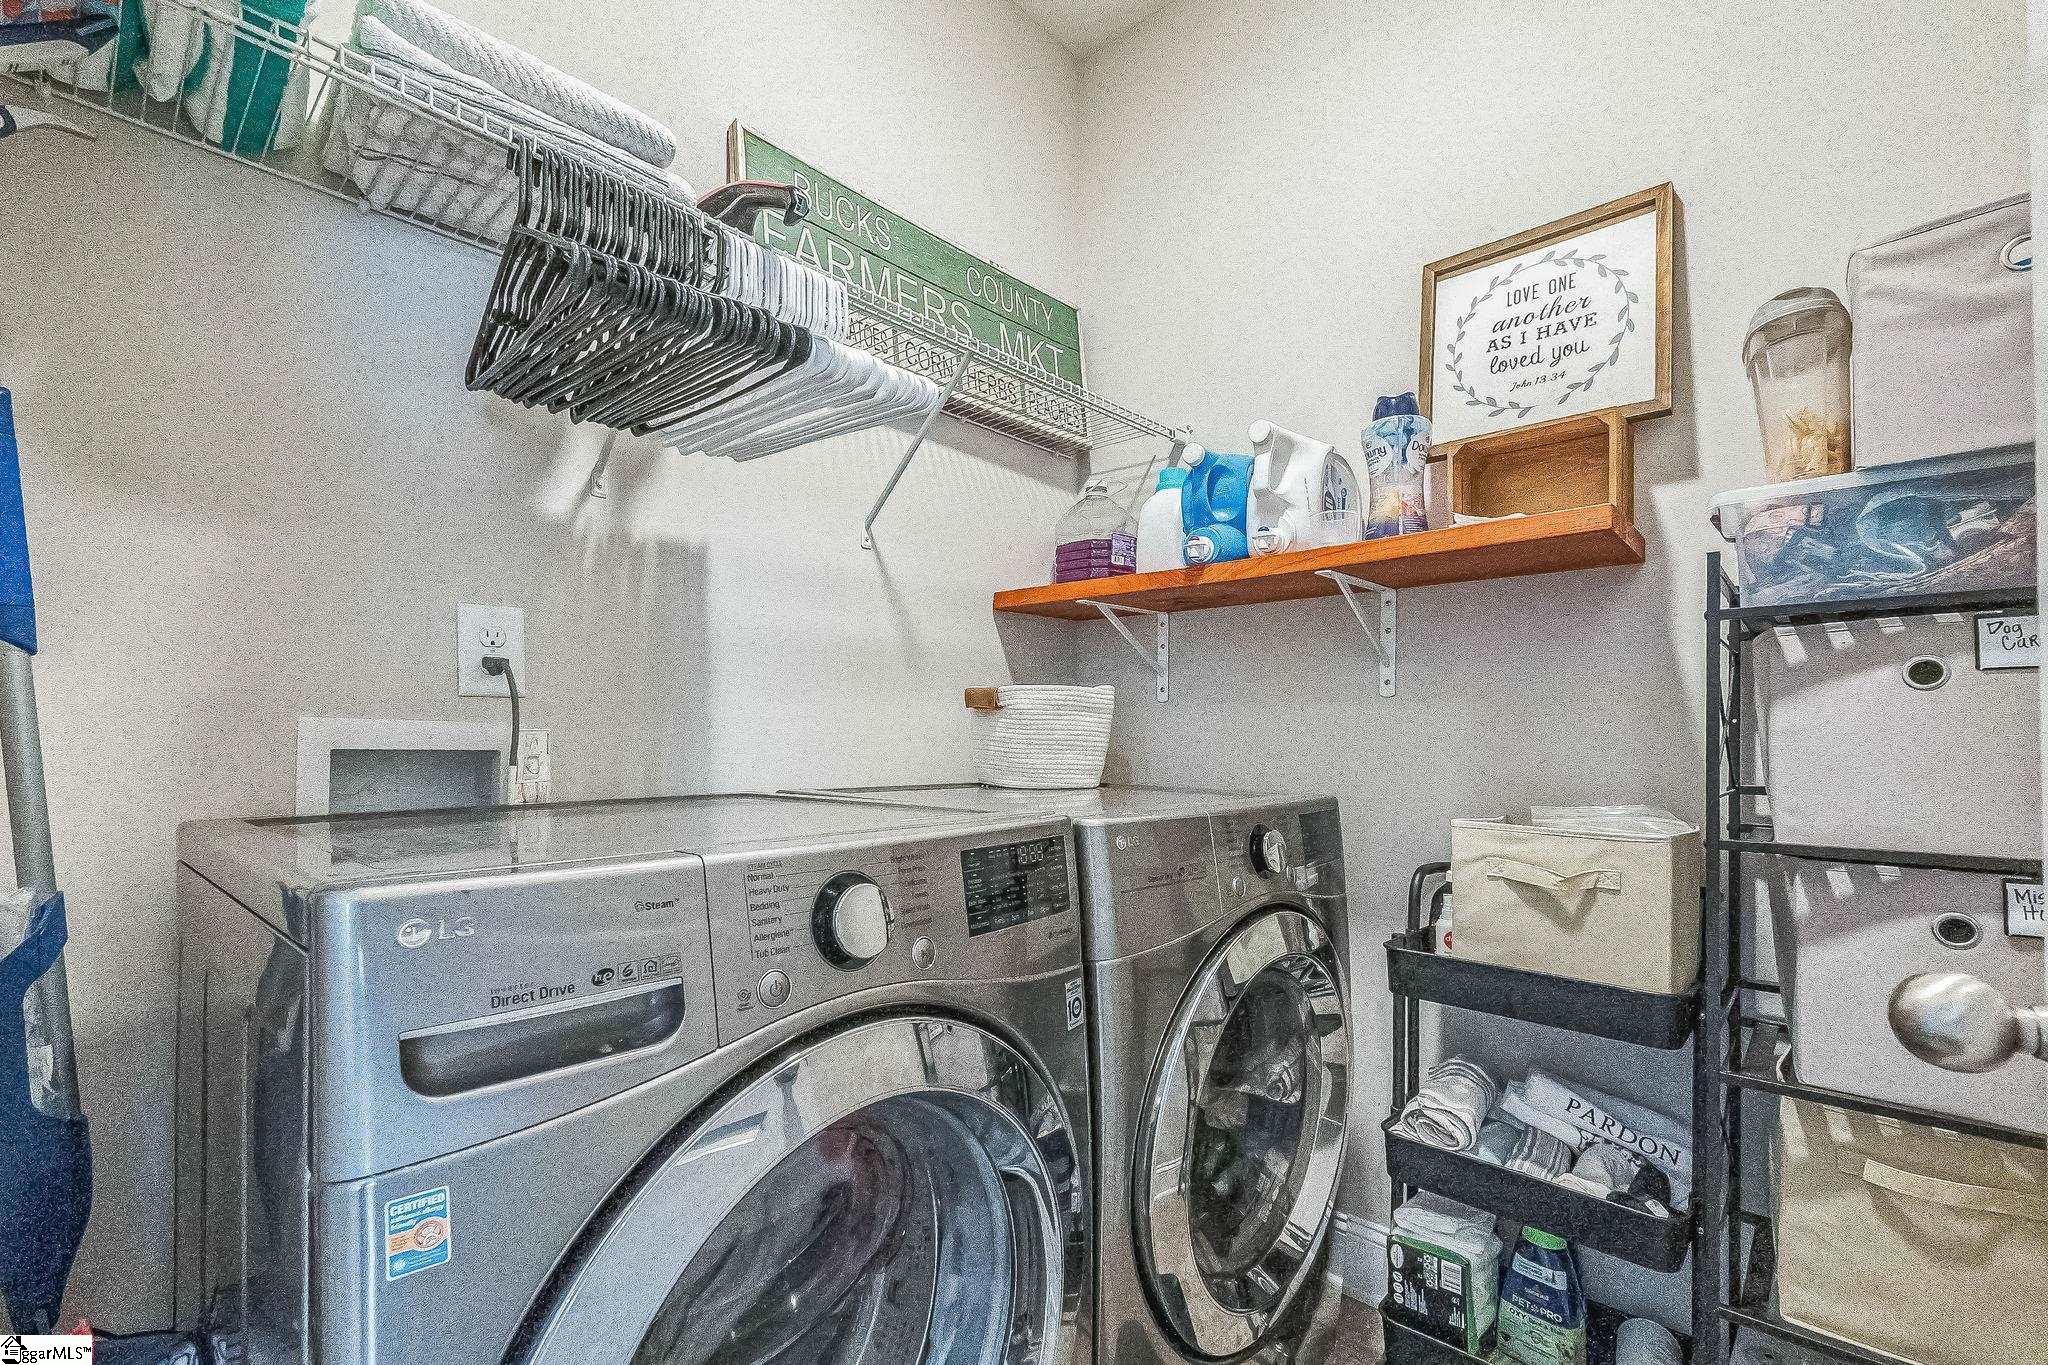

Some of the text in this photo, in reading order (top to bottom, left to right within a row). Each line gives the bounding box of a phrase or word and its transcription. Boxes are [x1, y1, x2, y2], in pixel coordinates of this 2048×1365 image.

[793, 170, 1054, 332] BUCKS COUNTY
[762, 208, 1064, 379] FARMERS MKT
[1507, 272, 1577, 307] LOVE ONE
[1492, 294, 1592, 333] another
[1486, 312, 1598, 353] AS I HAVE
[1490, 340, 1591, 375] loved you
[1509, 379, 1533, 393] John
[1986, 620, 2023, 639] Dog
[747, 872, 775, 883] Normal
[748, 884, 790, 897] Heavy Duty
[750, 901, 781, 912] Bedding
[756, 949, 770, 959] Tub
[491, 983, 576, 1009] Direct Drive
[1564, 1096, 1682, 1166] PARDON
[1512, 1293, 1532, 1309] PET
[1540, 1307, 1563, 1323] PRO
